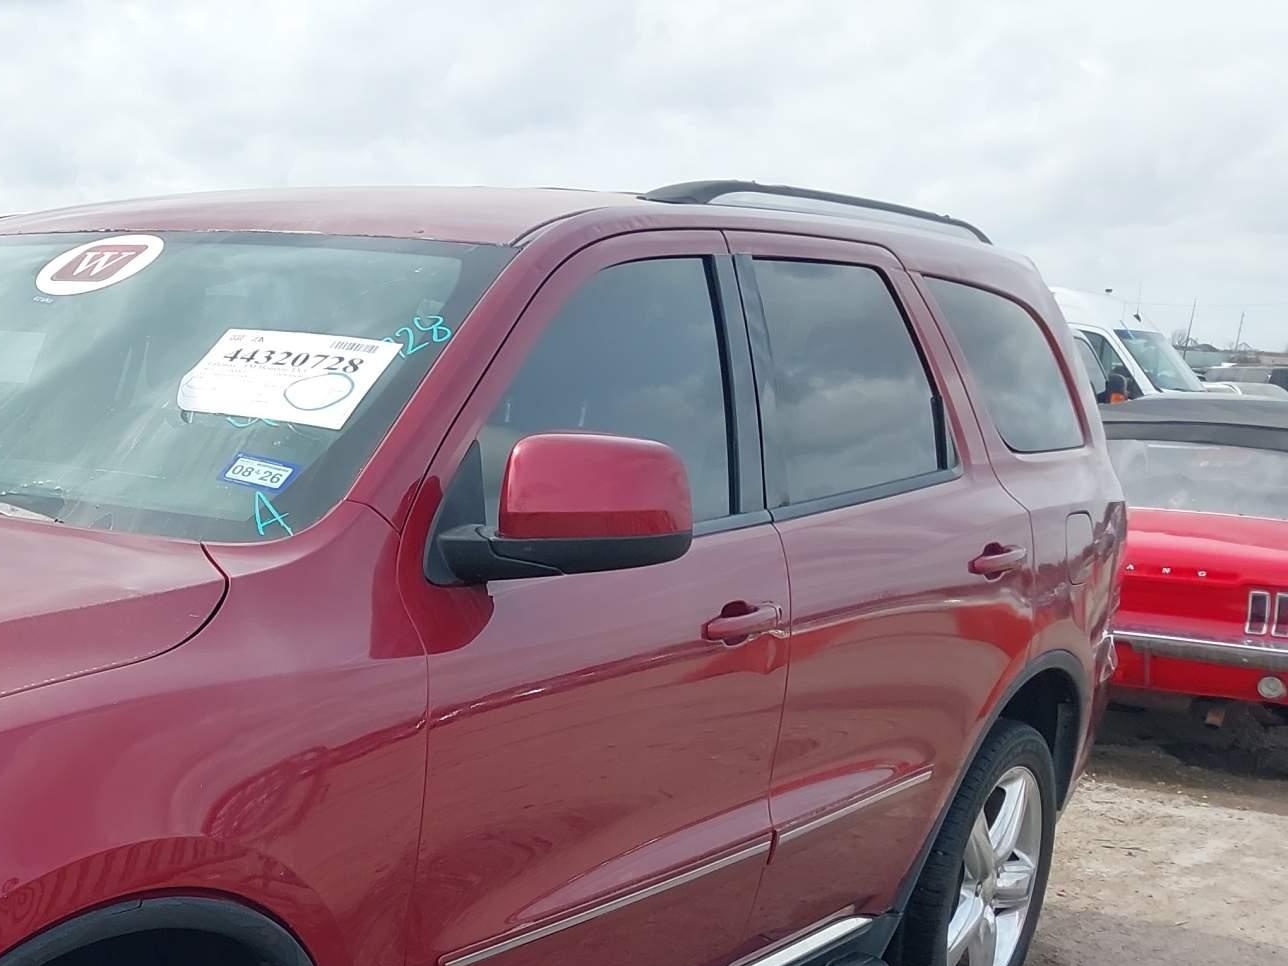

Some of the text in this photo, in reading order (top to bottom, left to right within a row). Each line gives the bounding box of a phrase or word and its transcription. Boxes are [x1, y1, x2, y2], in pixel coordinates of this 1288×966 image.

[72, 251, 136, 276] W
[223, 347, 364, 374] 44320728
[231, 464, 255, 478] 08
[258, 470, 283, 484] 26
